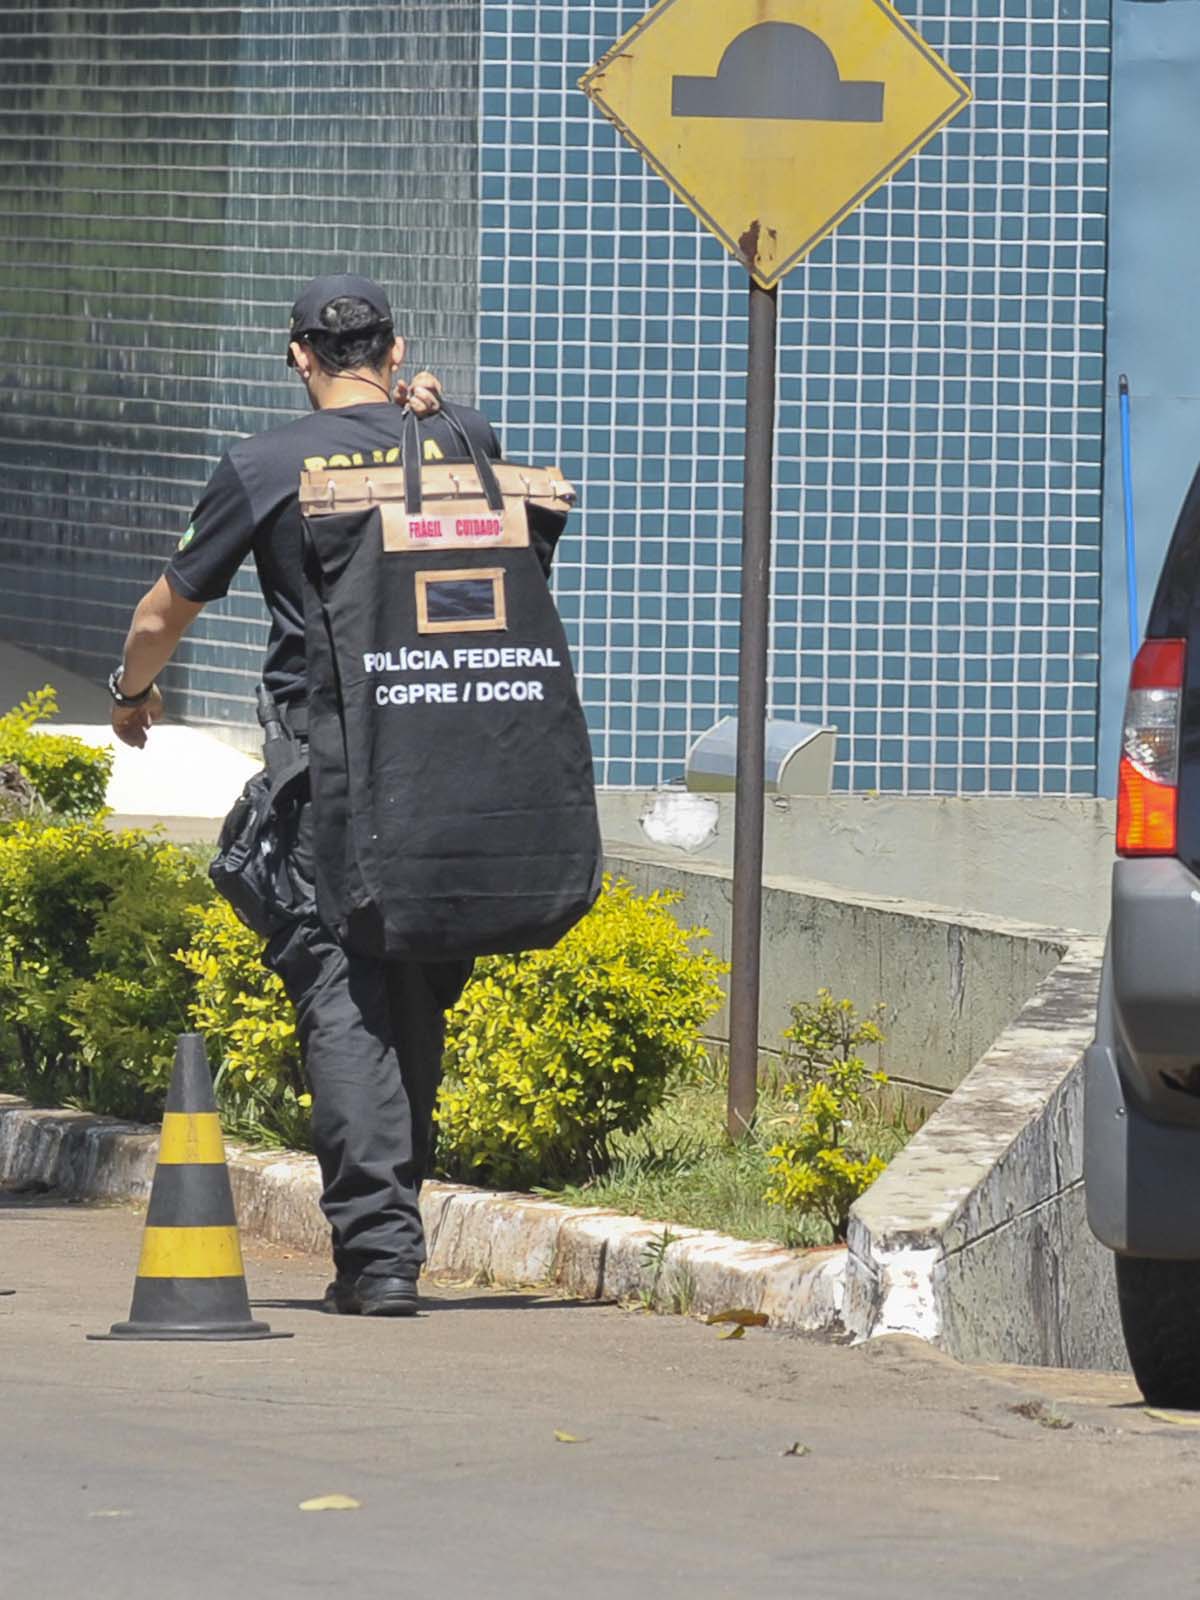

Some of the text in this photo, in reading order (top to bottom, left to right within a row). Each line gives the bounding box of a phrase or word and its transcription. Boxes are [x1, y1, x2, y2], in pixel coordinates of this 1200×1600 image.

[456, 519, 500, 537] CUIDADO
[363, 646, 561, 672] POLÍCIA FEDERAL
[376, 681, 545, 705] CGPRE / DCOR
